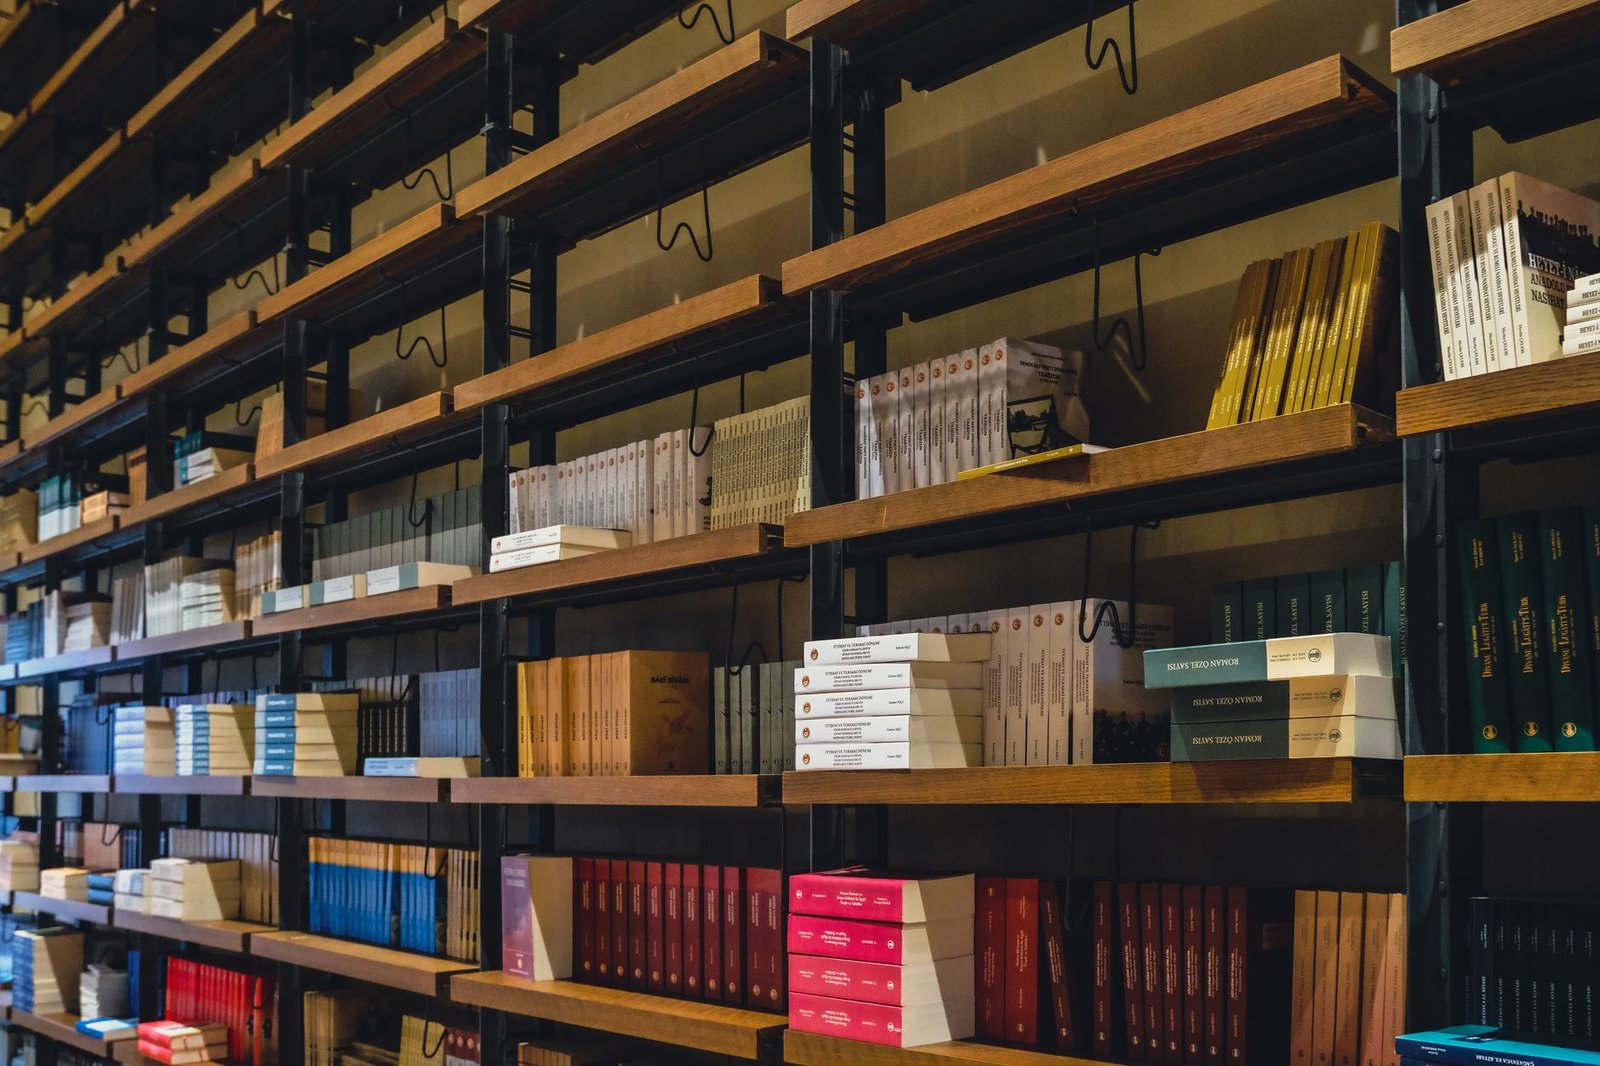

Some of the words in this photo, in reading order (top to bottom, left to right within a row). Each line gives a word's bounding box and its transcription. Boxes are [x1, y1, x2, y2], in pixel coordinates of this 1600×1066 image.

[1528, 252, 1567, 279] HEYET-İ
[1167, 662, 1189, 671] SAYISI
[1190, 660, 1209, 668] ÖZEL
[1210, 657, 1239, 667] ROMAN
[1193, 698, 1214, 706] SAYISI
[1214, 697, 1234, 706] ÖZEL
[1234, 695, 1263, 704] ROMAN
[1192, 736, 1214, 745] SAYISI
[1214, 736, 1234, 745] ÖZEL
[1234, 735, 1262, 744] ROMAN
